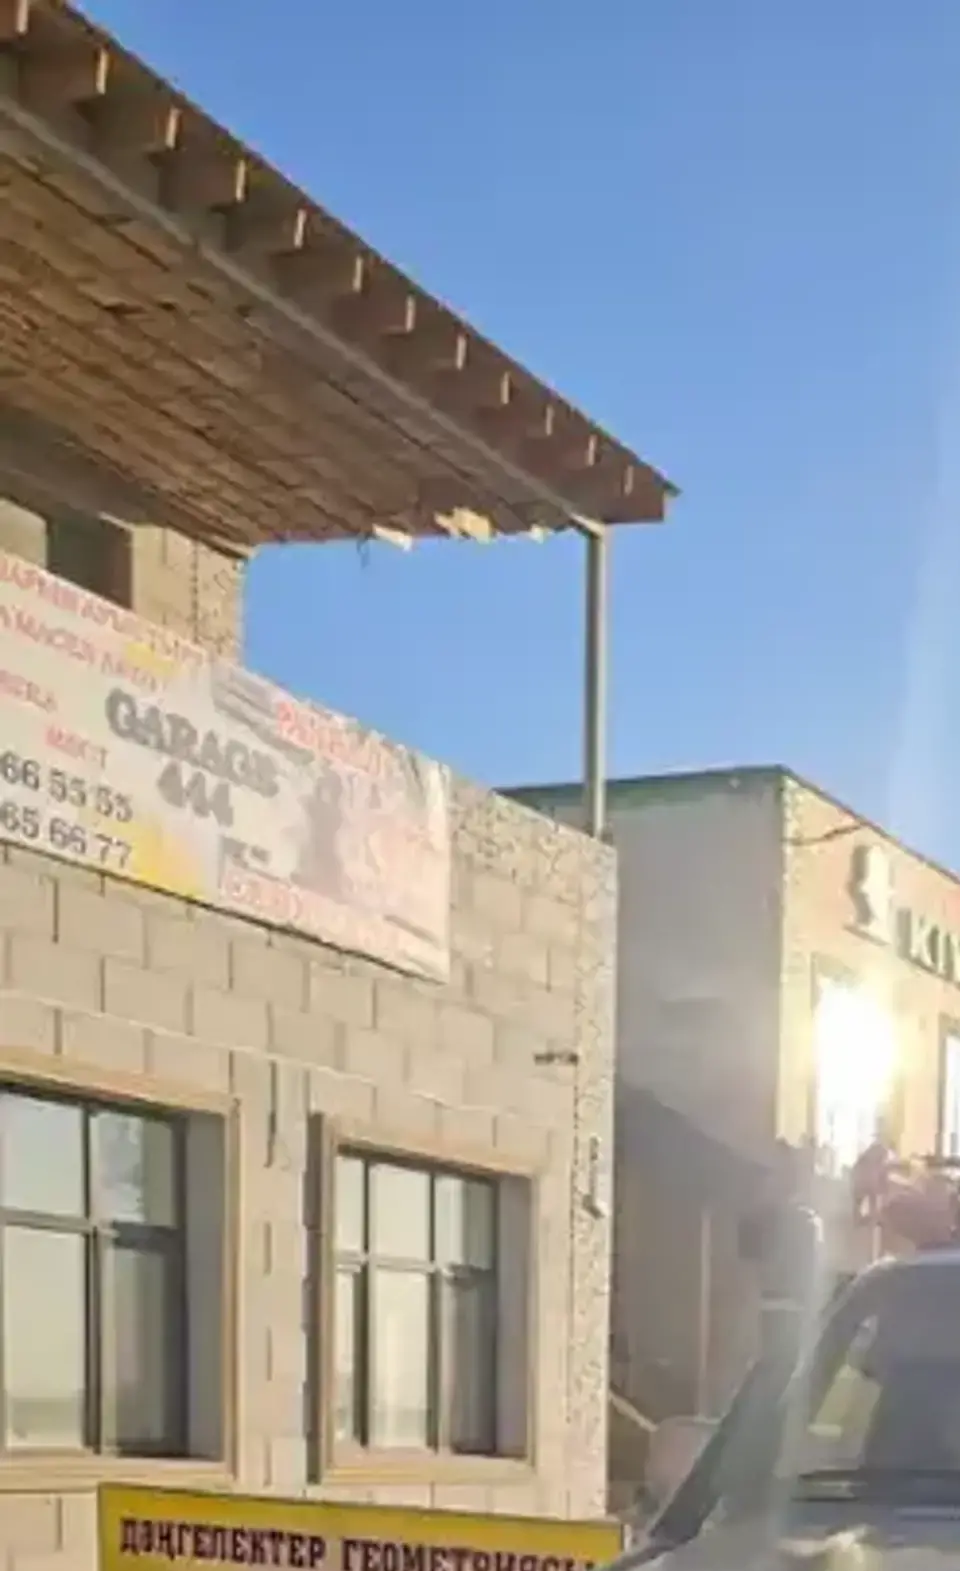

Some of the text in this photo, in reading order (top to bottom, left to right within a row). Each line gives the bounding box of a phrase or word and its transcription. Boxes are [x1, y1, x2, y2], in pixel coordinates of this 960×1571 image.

[105, 687, 280, 798] GARAGE
[156, 759, 234, 828] 444
[94, 833, 132, 868] 77
